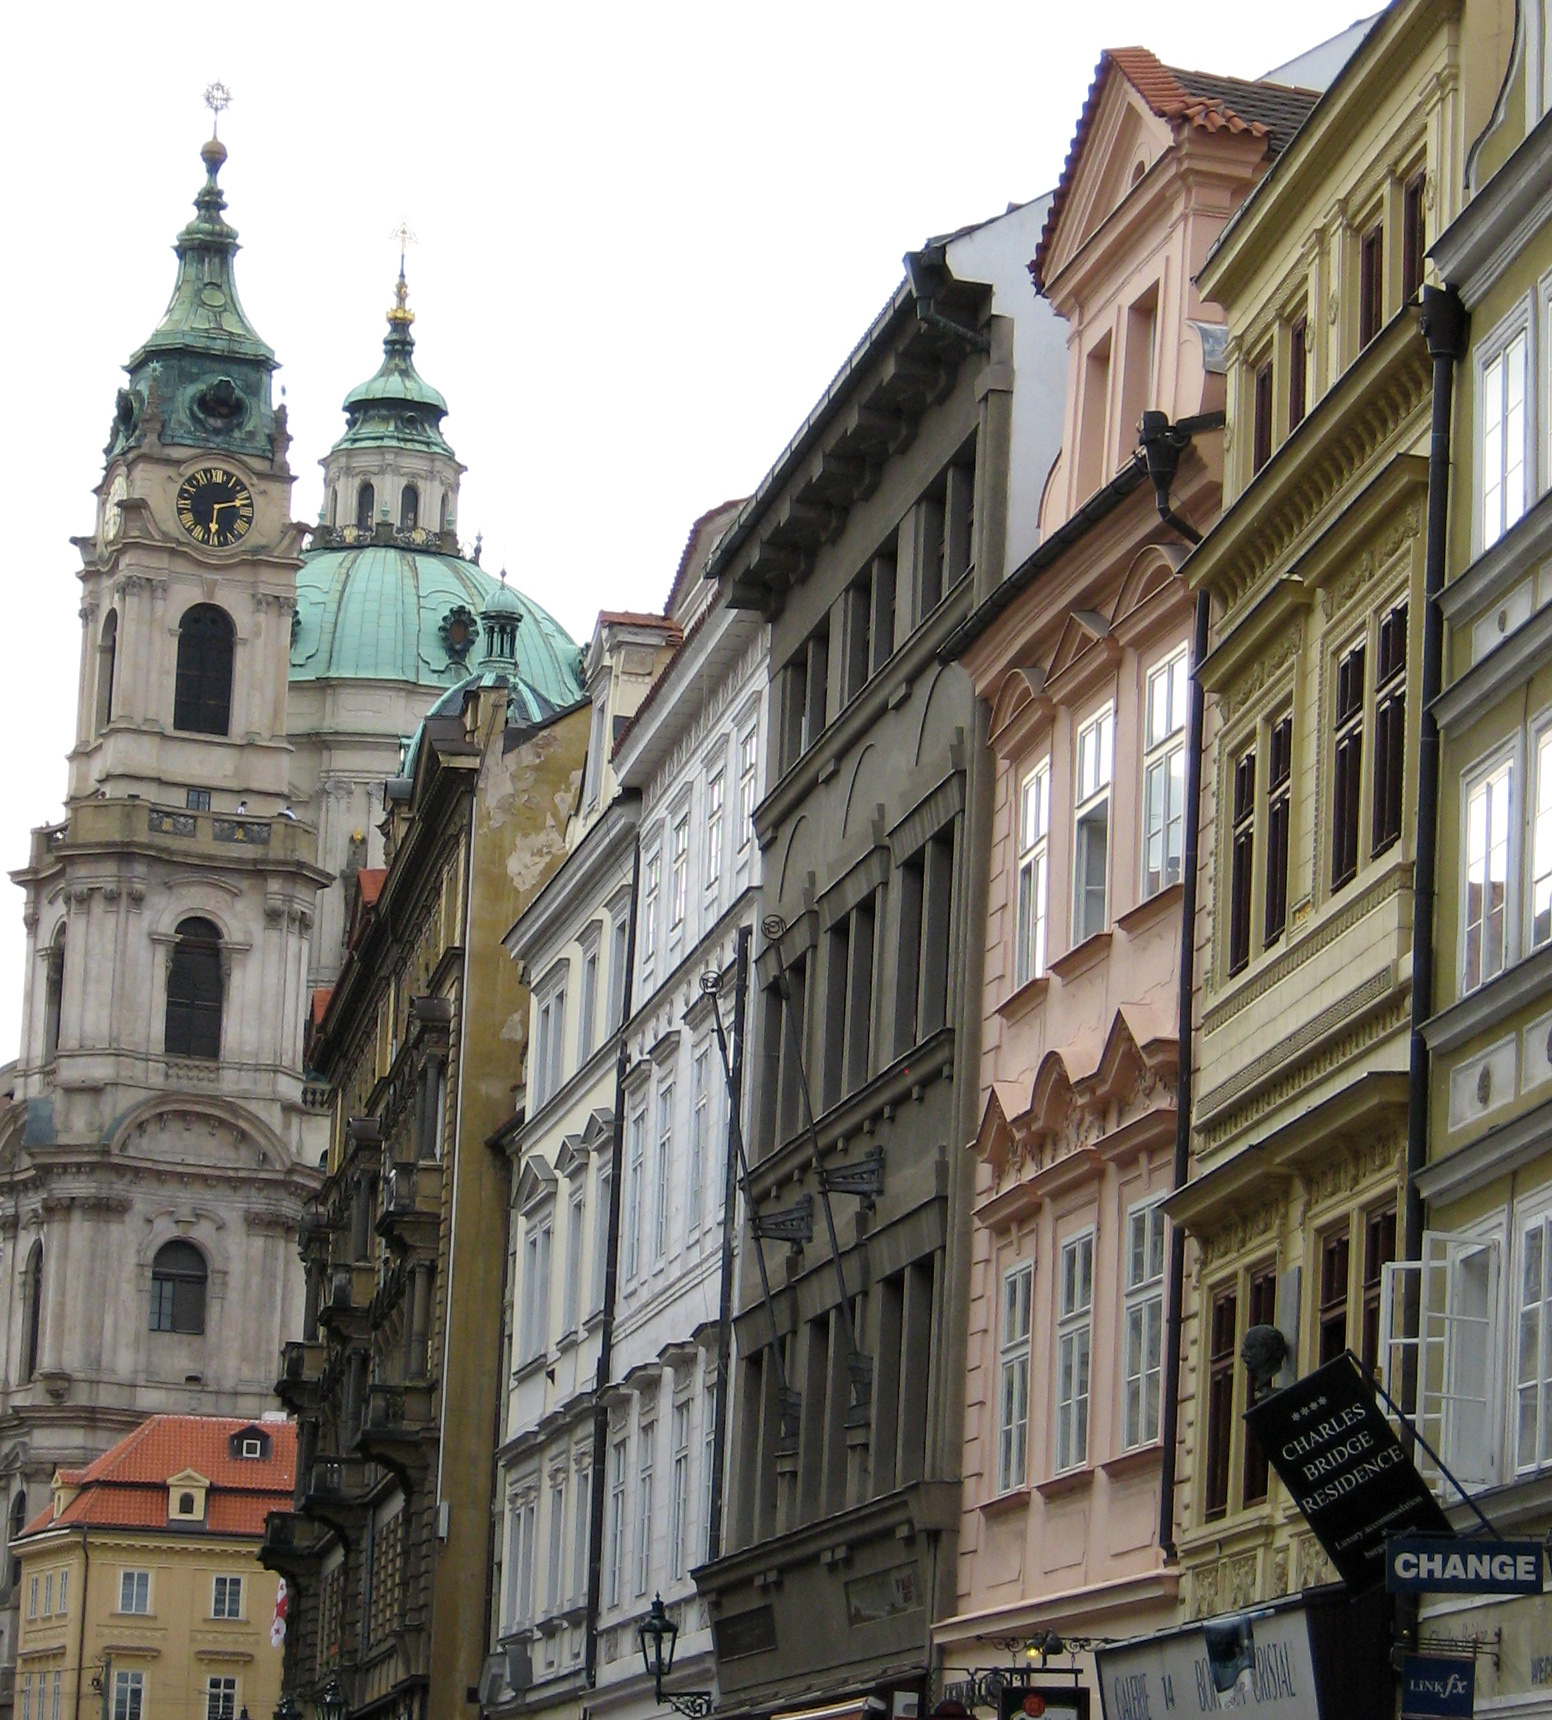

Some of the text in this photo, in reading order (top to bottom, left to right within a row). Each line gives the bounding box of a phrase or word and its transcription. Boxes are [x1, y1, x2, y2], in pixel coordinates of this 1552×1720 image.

[1282, 1402, 1366, 1461] CHARLES
[1302, 1431, 1374, 1482] BRIDGE
[1302, 1445, 1404, 1514] RESIDENCE
[1394, 1553, 1536, 1580] CHANGE
